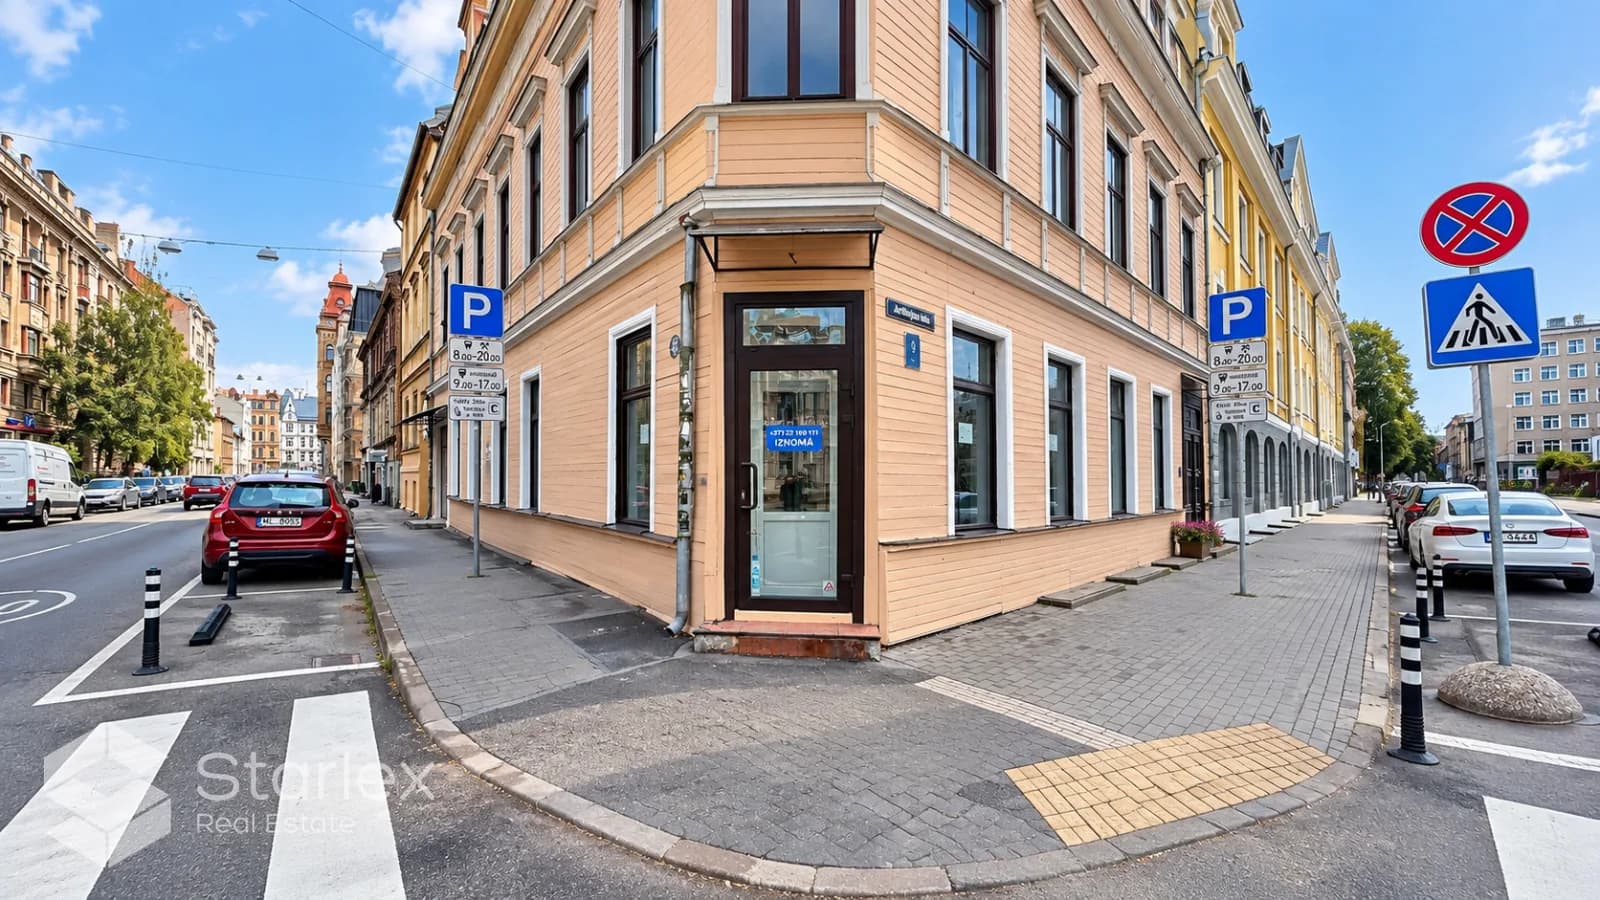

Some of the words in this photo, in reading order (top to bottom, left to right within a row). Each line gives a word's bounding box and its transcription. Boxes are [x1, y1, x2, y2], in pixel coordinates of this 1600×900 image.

[463, 291, 492, 329] P
[1222, 295, 1253, 335] P
[492, 405, 500, 415] C
[1252, 403, 1260, 414] C
